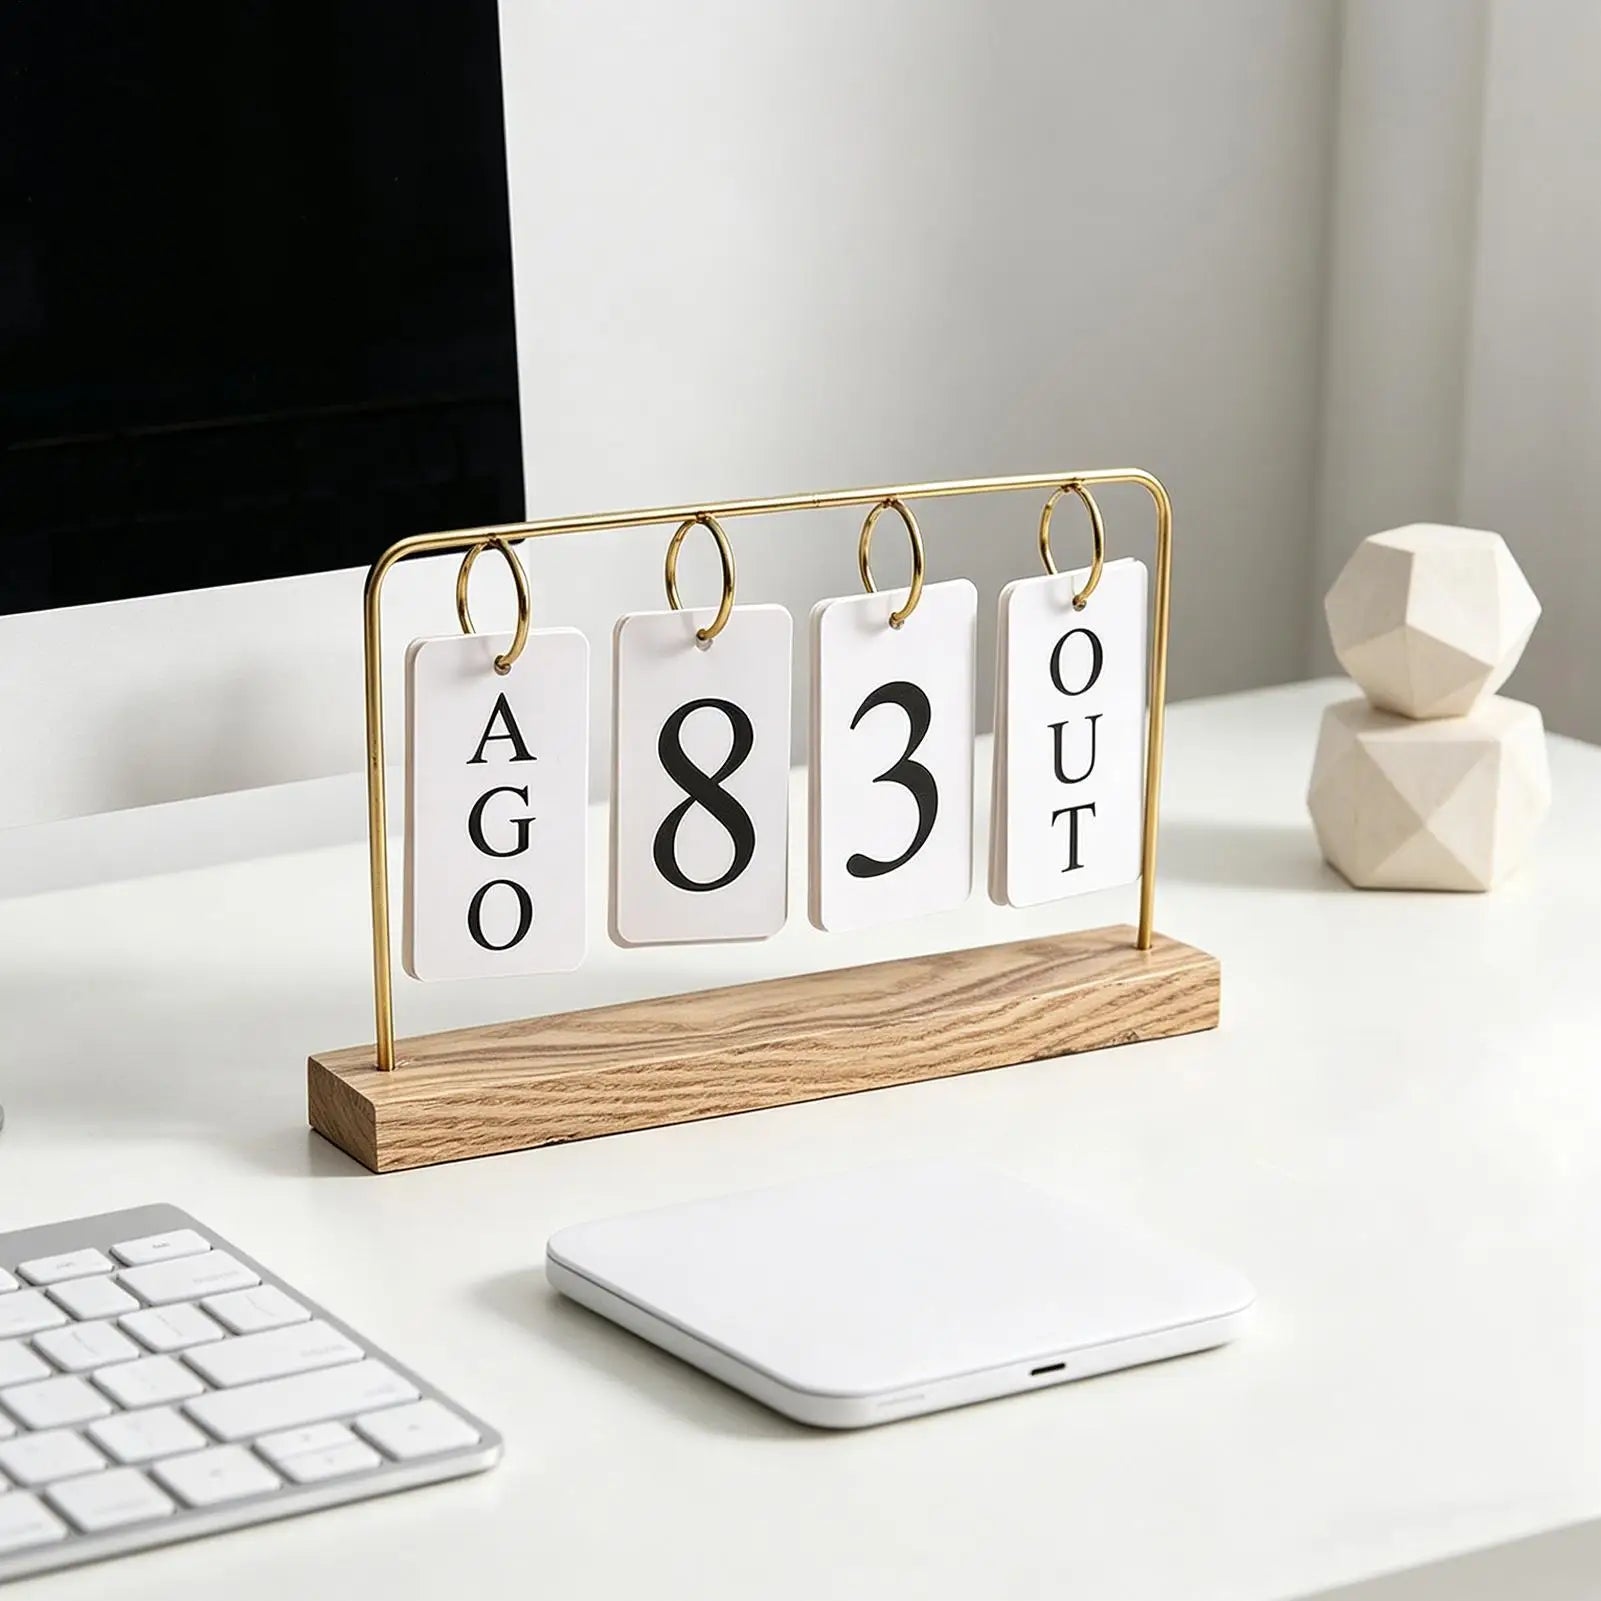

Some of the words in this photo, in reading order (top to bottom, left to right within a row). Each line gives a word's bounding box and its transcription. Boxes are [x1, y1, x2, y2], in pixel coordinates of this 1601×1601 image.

[466, 692, 538, 951] AGO
[652, 698, 756, 892] 8
[846, 681, 939, 879] 3
[1047, 628, 1104, 873] OUT
